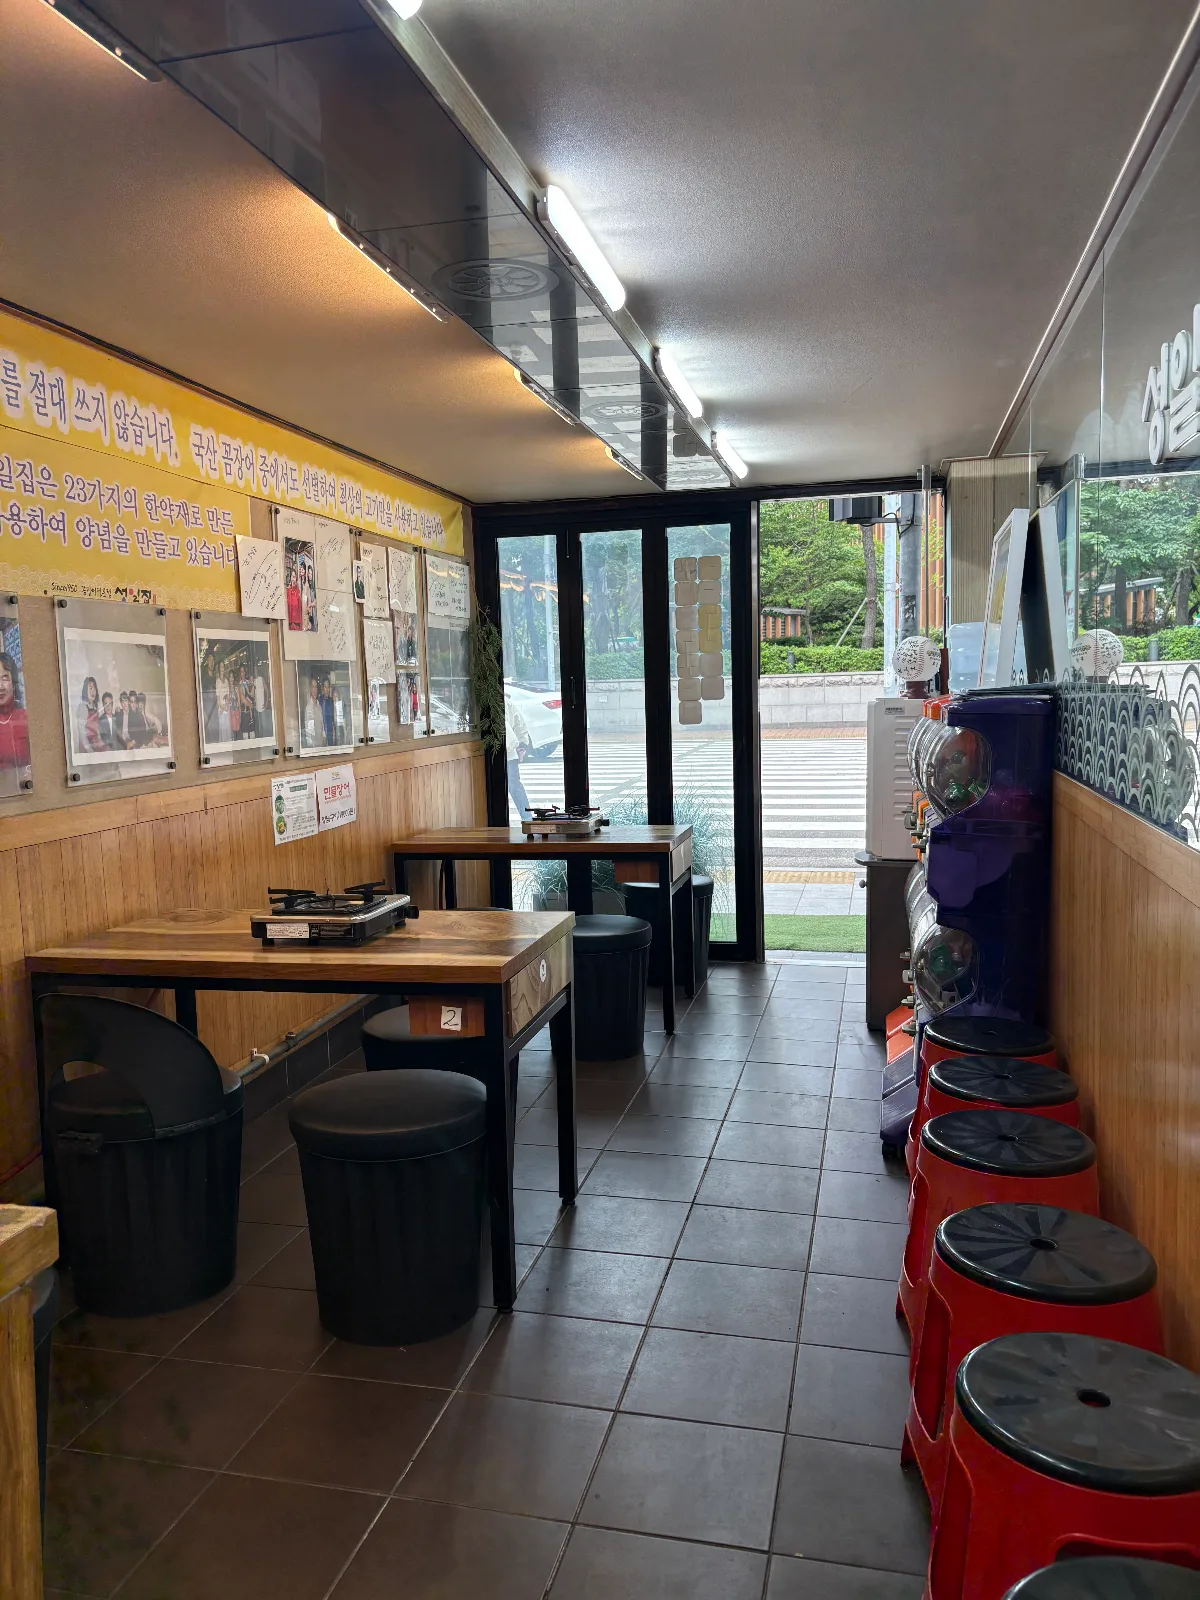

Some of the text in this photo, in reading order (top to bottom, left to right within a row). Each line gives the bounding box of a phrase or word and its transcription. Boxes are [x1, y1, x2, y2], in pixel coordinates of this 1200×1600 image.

[1, 359, 22, 409] 를
[30, 370, 67, 425] 절대
[75, 388, 108, 437] 쓰지
[113, 399, 179, 459] 않습니다.
[192, 431, 218, 472] 국산
[222, 441, 256, 485] 꼼장어
[259, 454, 300, 496] 중에서도
[302, 468, 338, 510] 선별하여
[339, 482, 364, 519] 최상의
[365, 495, 393, 527] 고기만을
[395, 503, 420, 535] 사용하고
[0, 455, 234, 536] 일집은 23가지의 한약재로 만든
[75, 516, 131, 554] 양념을
[135, 529, 182, 560] 만들고
[323, 781, 351, 801] 민물장어
[442, 1009, 460, 1027] 2
